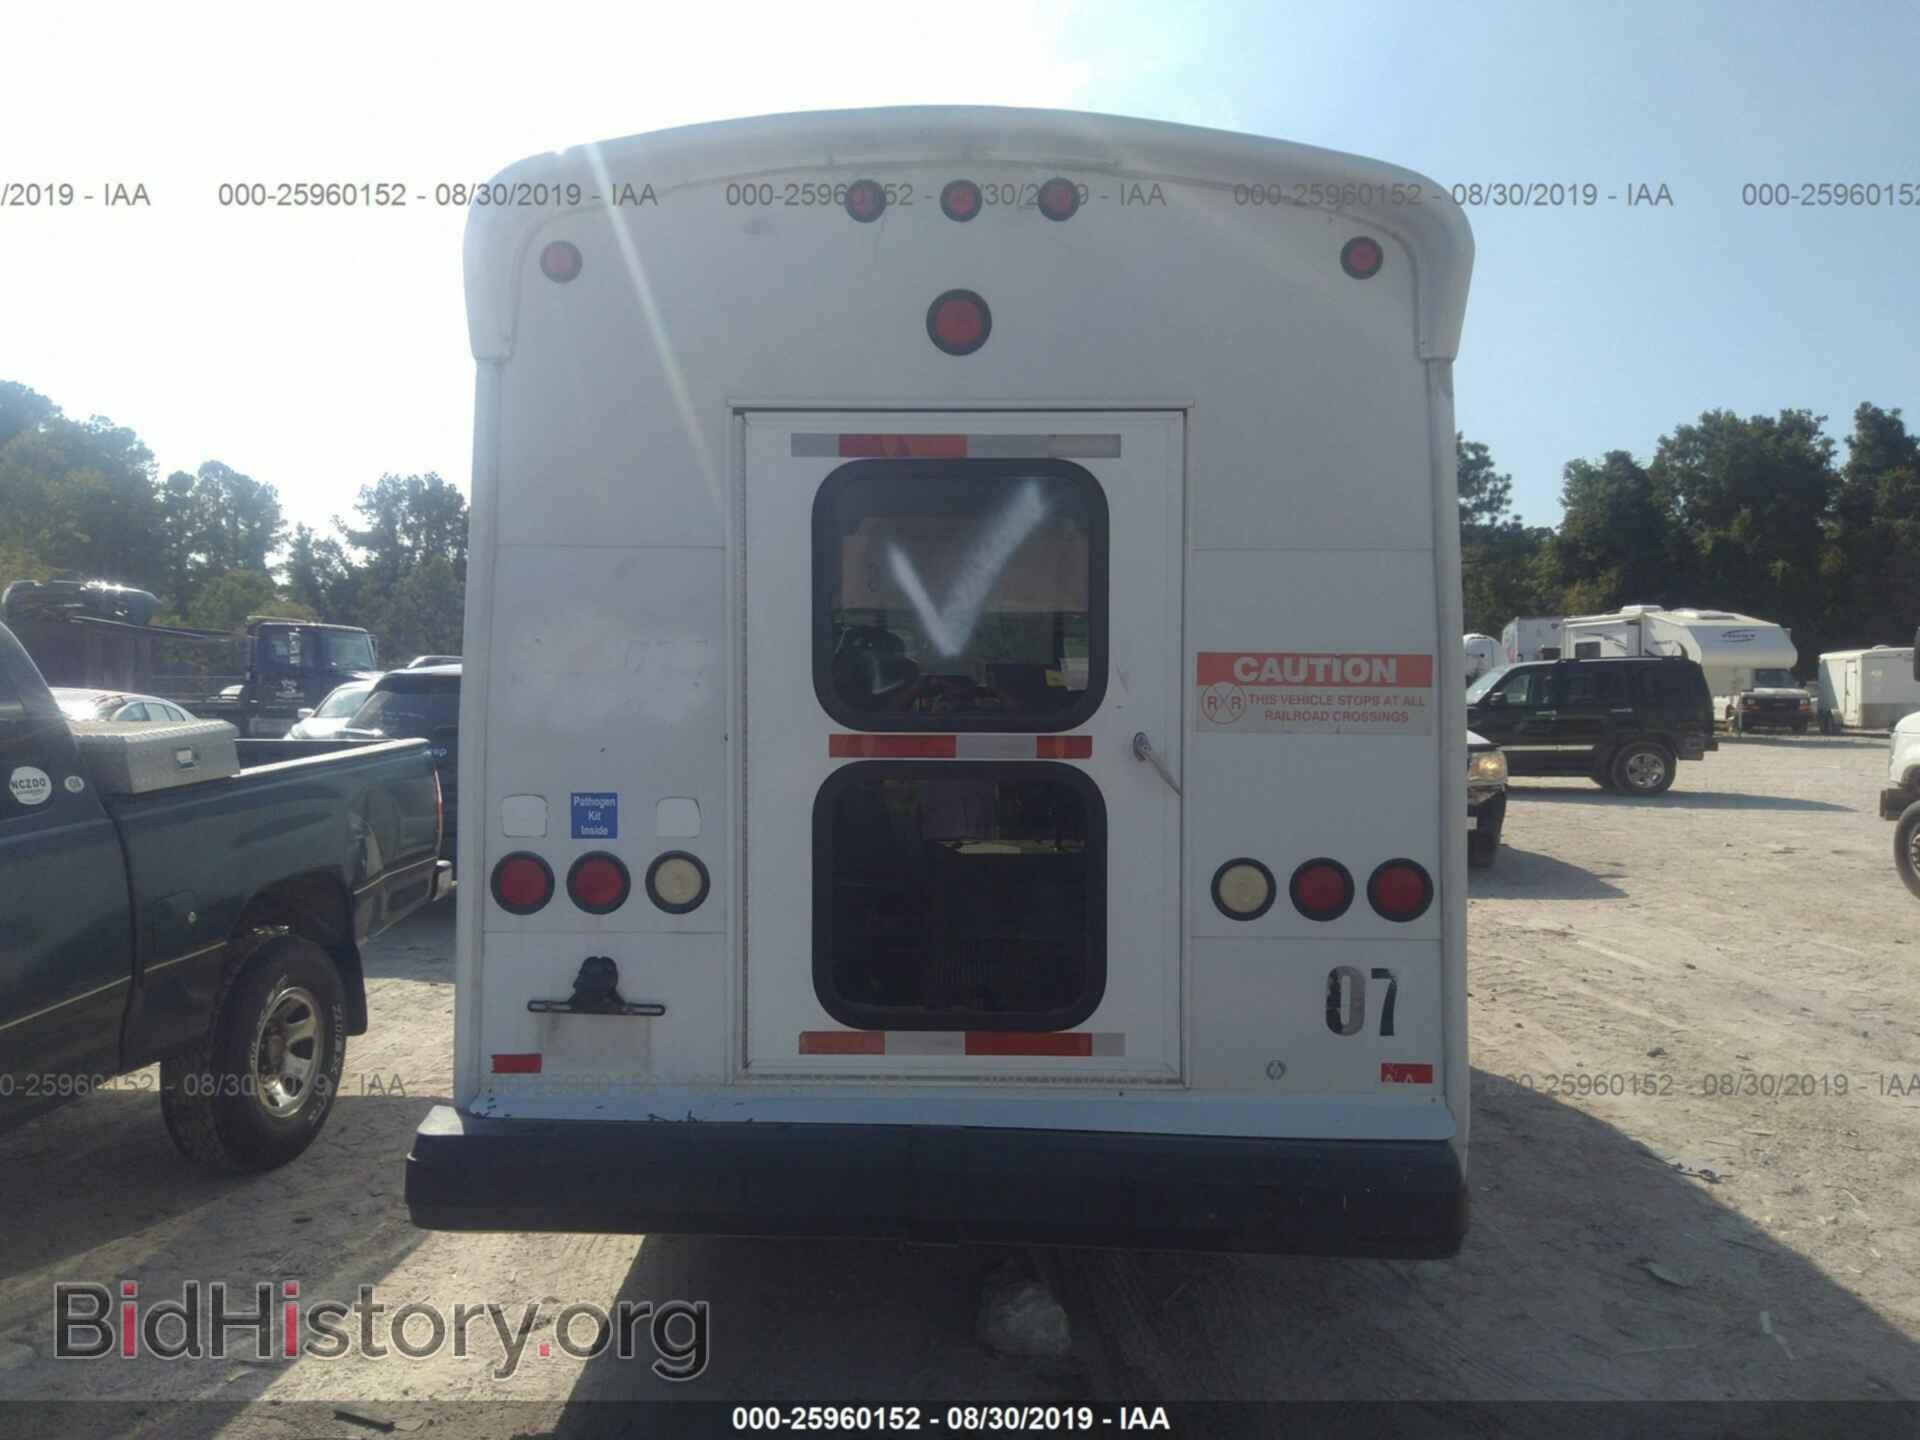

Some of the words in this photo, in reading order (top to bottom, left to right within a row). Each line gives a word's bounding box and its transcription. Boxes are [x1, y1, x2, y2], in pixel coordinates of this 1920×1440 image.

[1233, 656, 1398, 684] CAUTION
[1248, 693, 1278, 706] THIS
[1281, 694, 1334, 707] VEHICLE
[1338, 694, 1381, 707] STOPS
[1384, 695, 1400, 707] AT
[1404, 695, 1425, 707] ALL
[1264, 710, 1330, 722] RAILROAD
[1332, 710, 1409, 723] CROSSINGS
[573, 795, 616, 809] Pathogen
[588, 810, 601, 821] Kit
[580, 825, 609, 836] Inside
[1326, 966, 1398, 1037] 07
